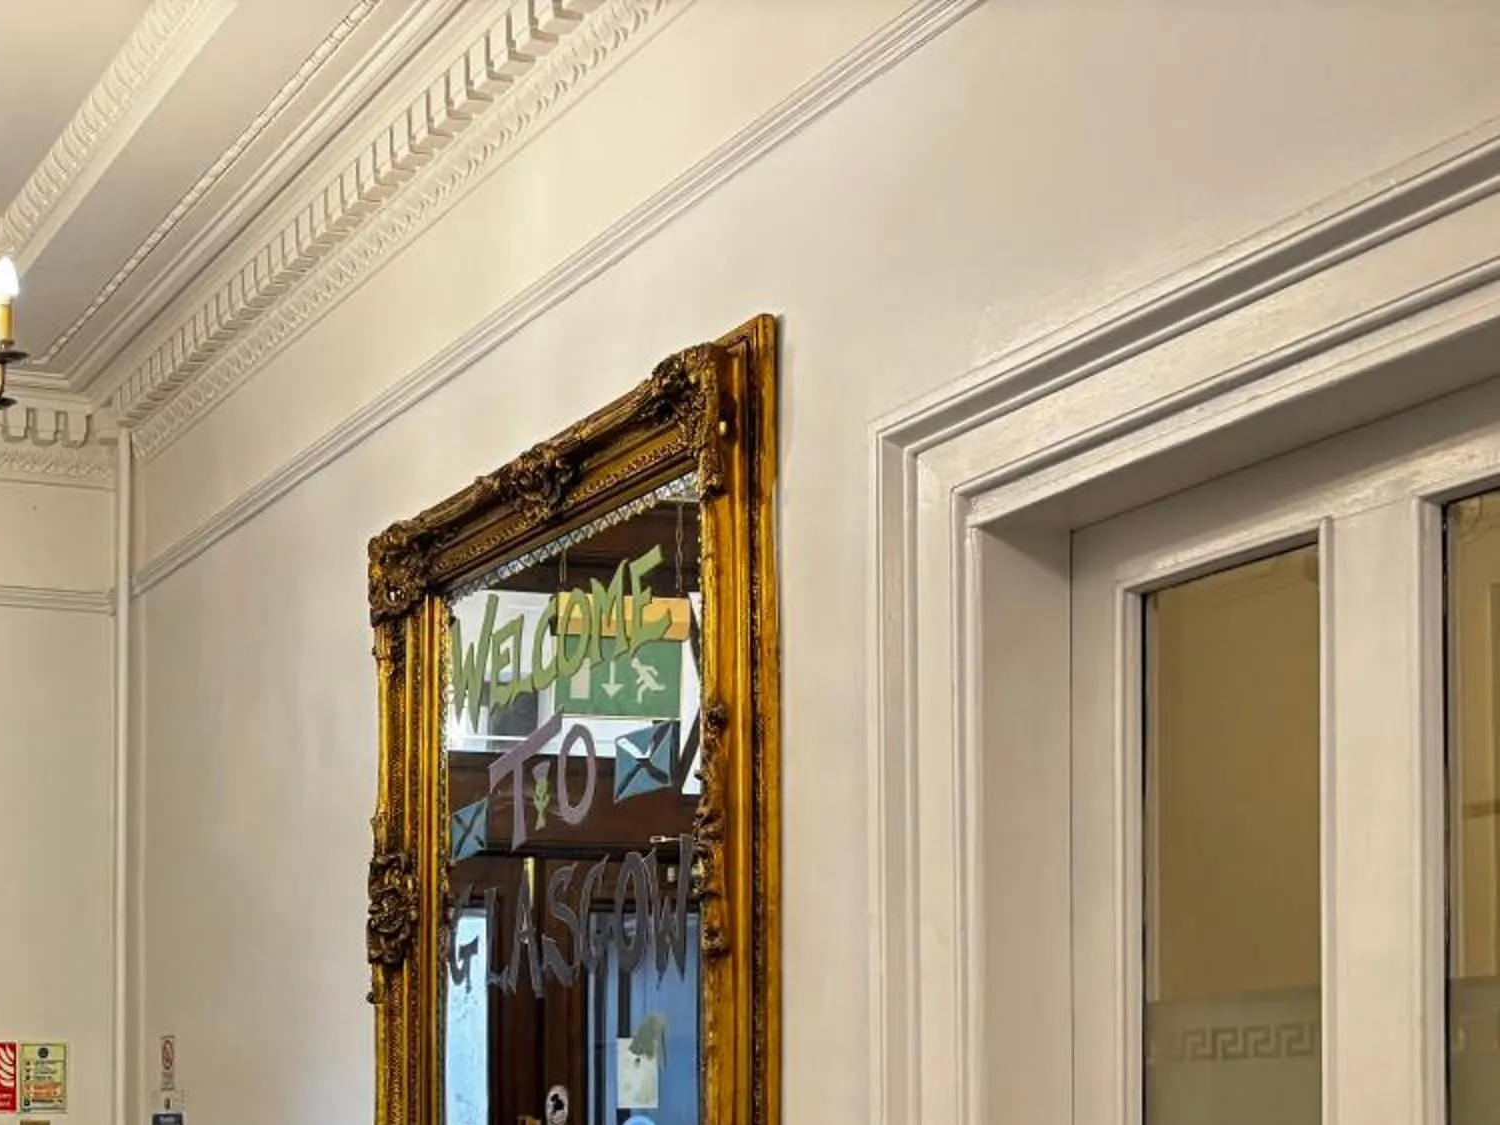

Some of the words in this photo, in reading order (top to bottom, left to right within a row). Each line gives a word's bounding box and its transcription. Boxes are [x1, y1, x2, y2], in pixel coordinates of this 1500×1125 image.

[450, 544, 673, 733] WELCOME
[489, 706, 596, 851] TO
[448, 833, 693, 998] GLASGOW
